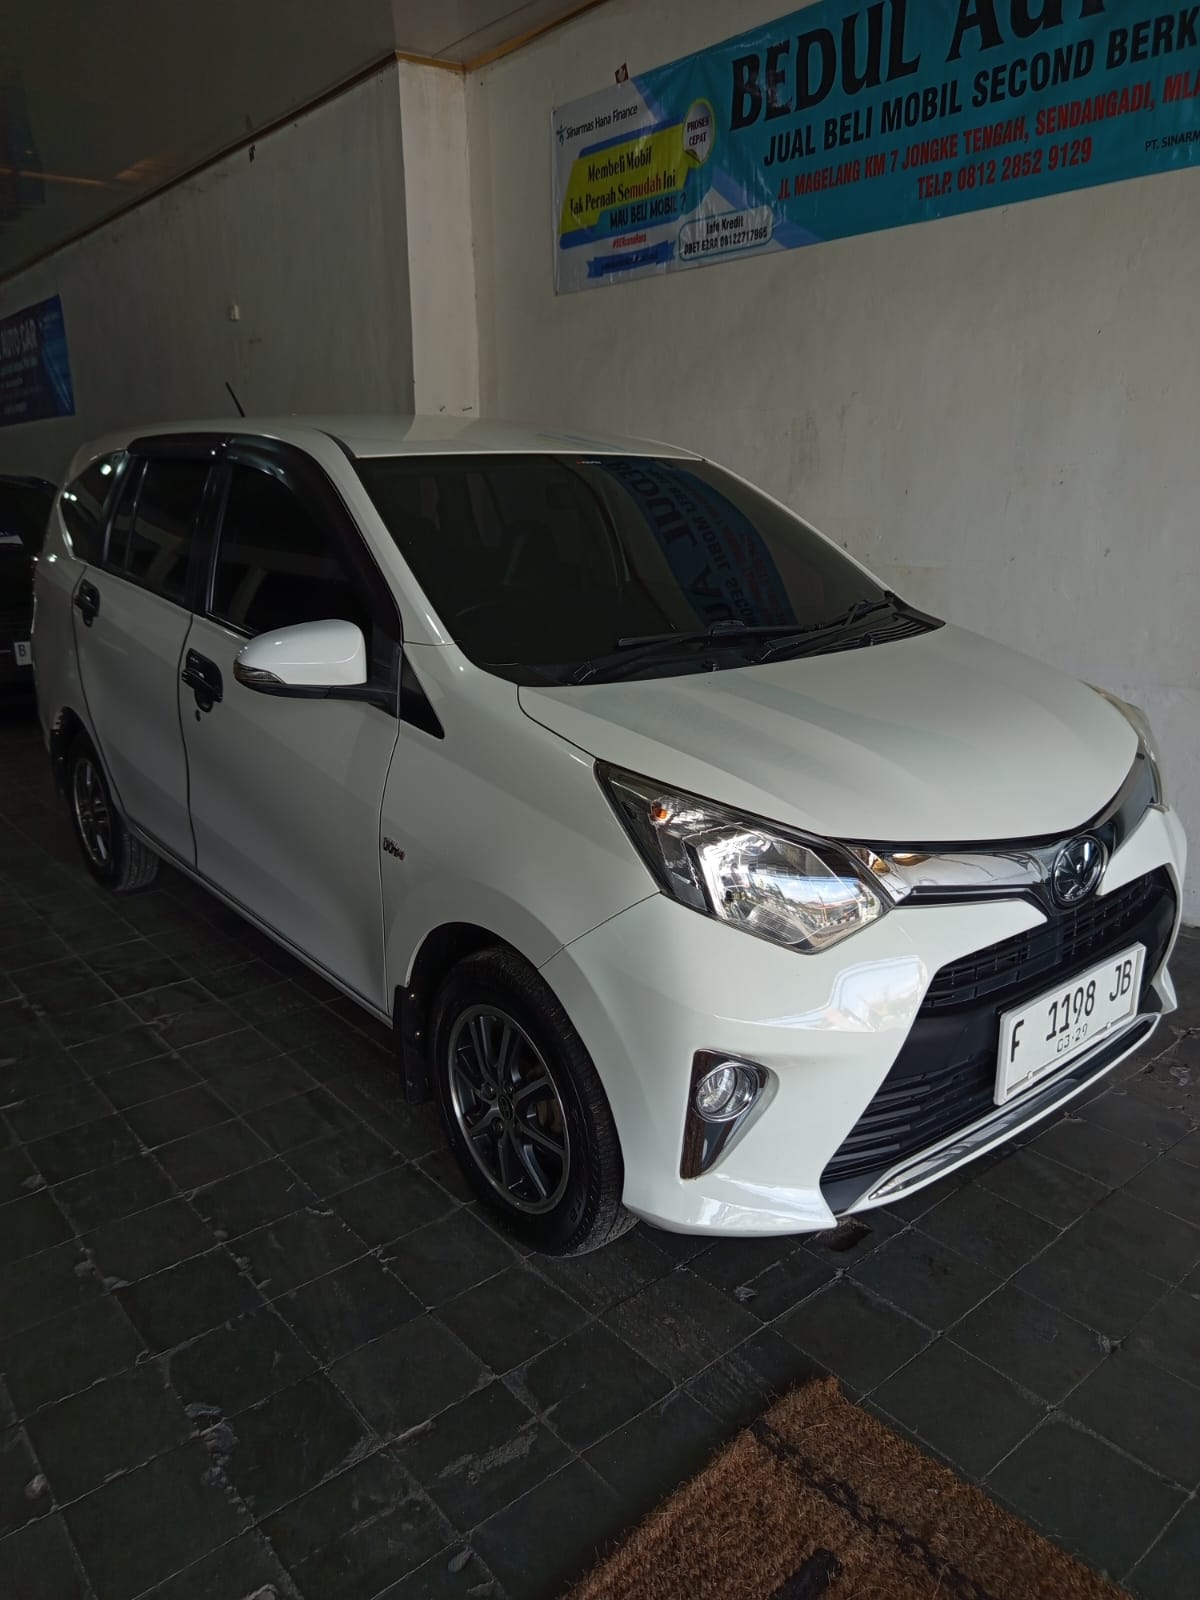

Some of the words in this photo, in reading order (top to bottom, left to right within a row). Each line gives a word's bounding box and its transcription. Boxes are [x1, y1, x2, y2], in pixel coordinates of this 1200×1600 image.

[729, 0, 922, 131] BEDUL
[565, 121, 595, 140] Sinarmas
[595, 114, 612, 129] Hana
[613, 104, 639, 121] Finance
[764, 128, 816, 167] JUAL
[823, 114, 872, 150] BELI
[880, 77, 962, 135] MOBIL
[972, 38, 1095, 108] SECOND
[689, 133, 707, 147] CEPAT
[795, 158, 861, 196] MAGELANG
[865, 154, 886, 180] KM
[890, 149, 899, 173] 7
[902, 133, 958, 171] JONGKE
[964, 116, 1029, 153] TENGAH,
[1035, 80, 1156, 138] SENDANGADI,
[1145, 138, 1160, 153] PT.
[587, 152, 625, 182] Membeli
[627, 146, 652, 171] Mobil
[917, 172, 952, 200] TELP.
[957, 162, 998, 191] 0812
[1001, 149, 1043, 181] 2852
[1048, 136, 1093, 173] 9129
[569, 198, 584, 217] Tak
[585, 188, 617, 212] Pernah
[618, 178, 662, 204] Semudah
[663, 173, 676, 191] Ini
[609, 209, 628, 230] MAU
[722, 215, 744, 230] Kredit
[1010, 1018, 1025, 1063] F
[1045, 979, 1097, 1042] 1198
[1109, 959, 1132, 1002] JB
